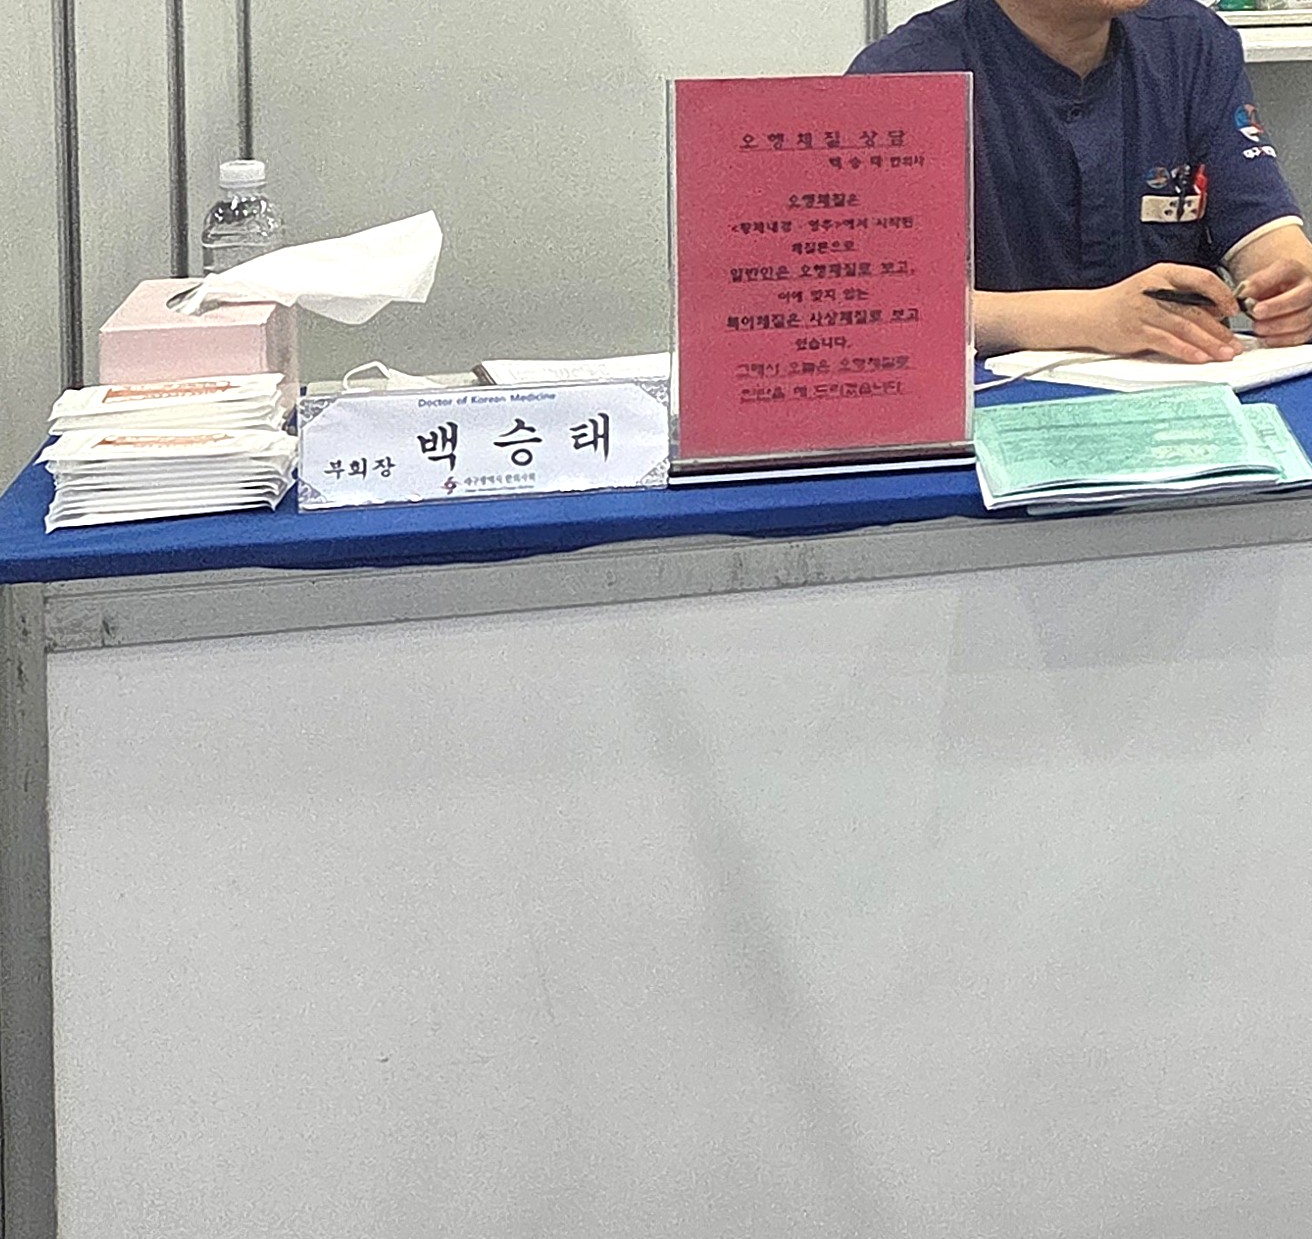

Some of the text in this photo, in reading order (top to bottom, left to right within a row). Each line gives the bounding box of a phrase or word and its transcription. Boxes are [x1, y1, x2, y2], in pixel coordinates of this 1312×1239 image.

[730, 265, 790, 282] 일반인은
[799, 263, 873, 279] 오행체질로
[418, 391, 557, 408] Doctor of Korean Medicine
[324, 455, 397, 480] 부회장
